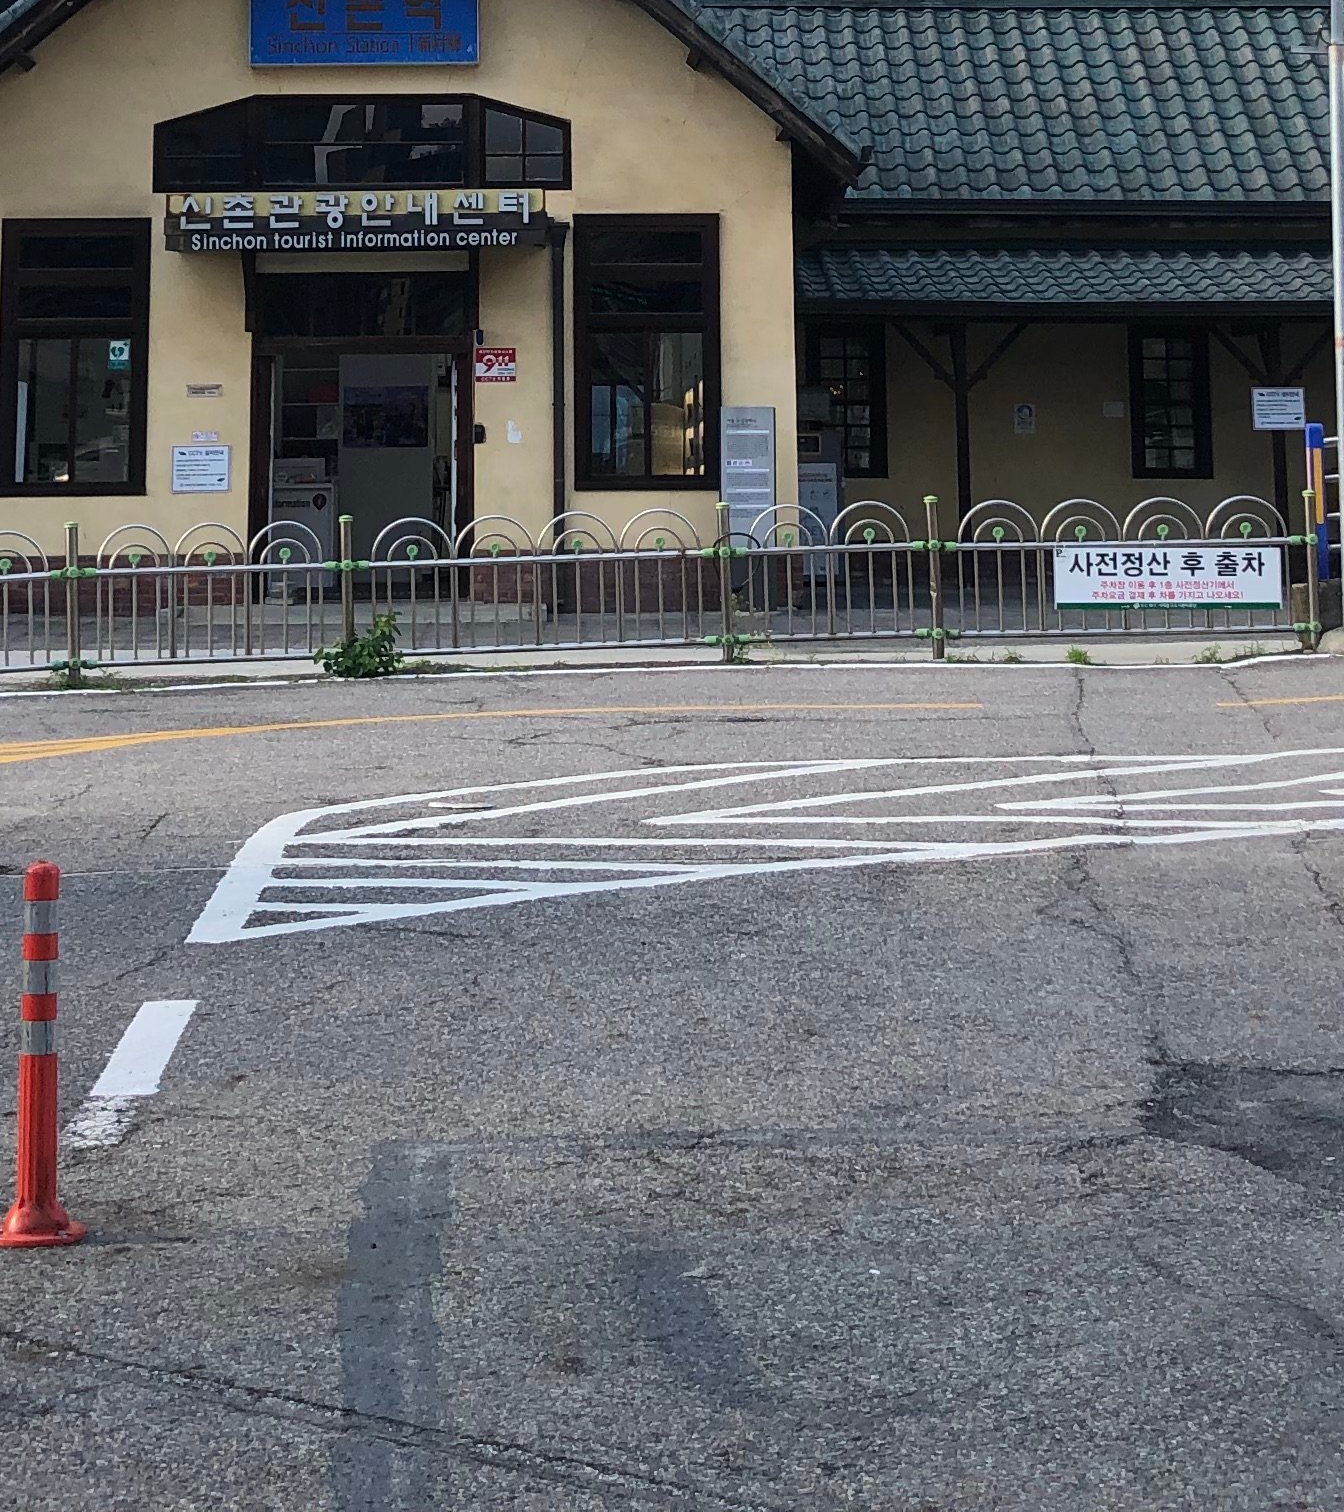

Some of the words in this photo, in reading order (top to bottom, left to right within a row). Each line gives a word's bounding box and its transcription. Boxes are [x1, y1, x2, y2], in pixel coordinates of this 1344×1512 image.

[179, 191, 530, 230] 신촌관광안내센터
[191, 232, 267, 251] Sinchon
[274, 231, 335, 250] tourist
[340, 229, 451, 248] information
[456, 229, 519, 247] center
[1069, 551, 1171, 577] 사전정산
[1180, 551, 1205, 577] 후
[1214, 551, 1266, 577] 출차
